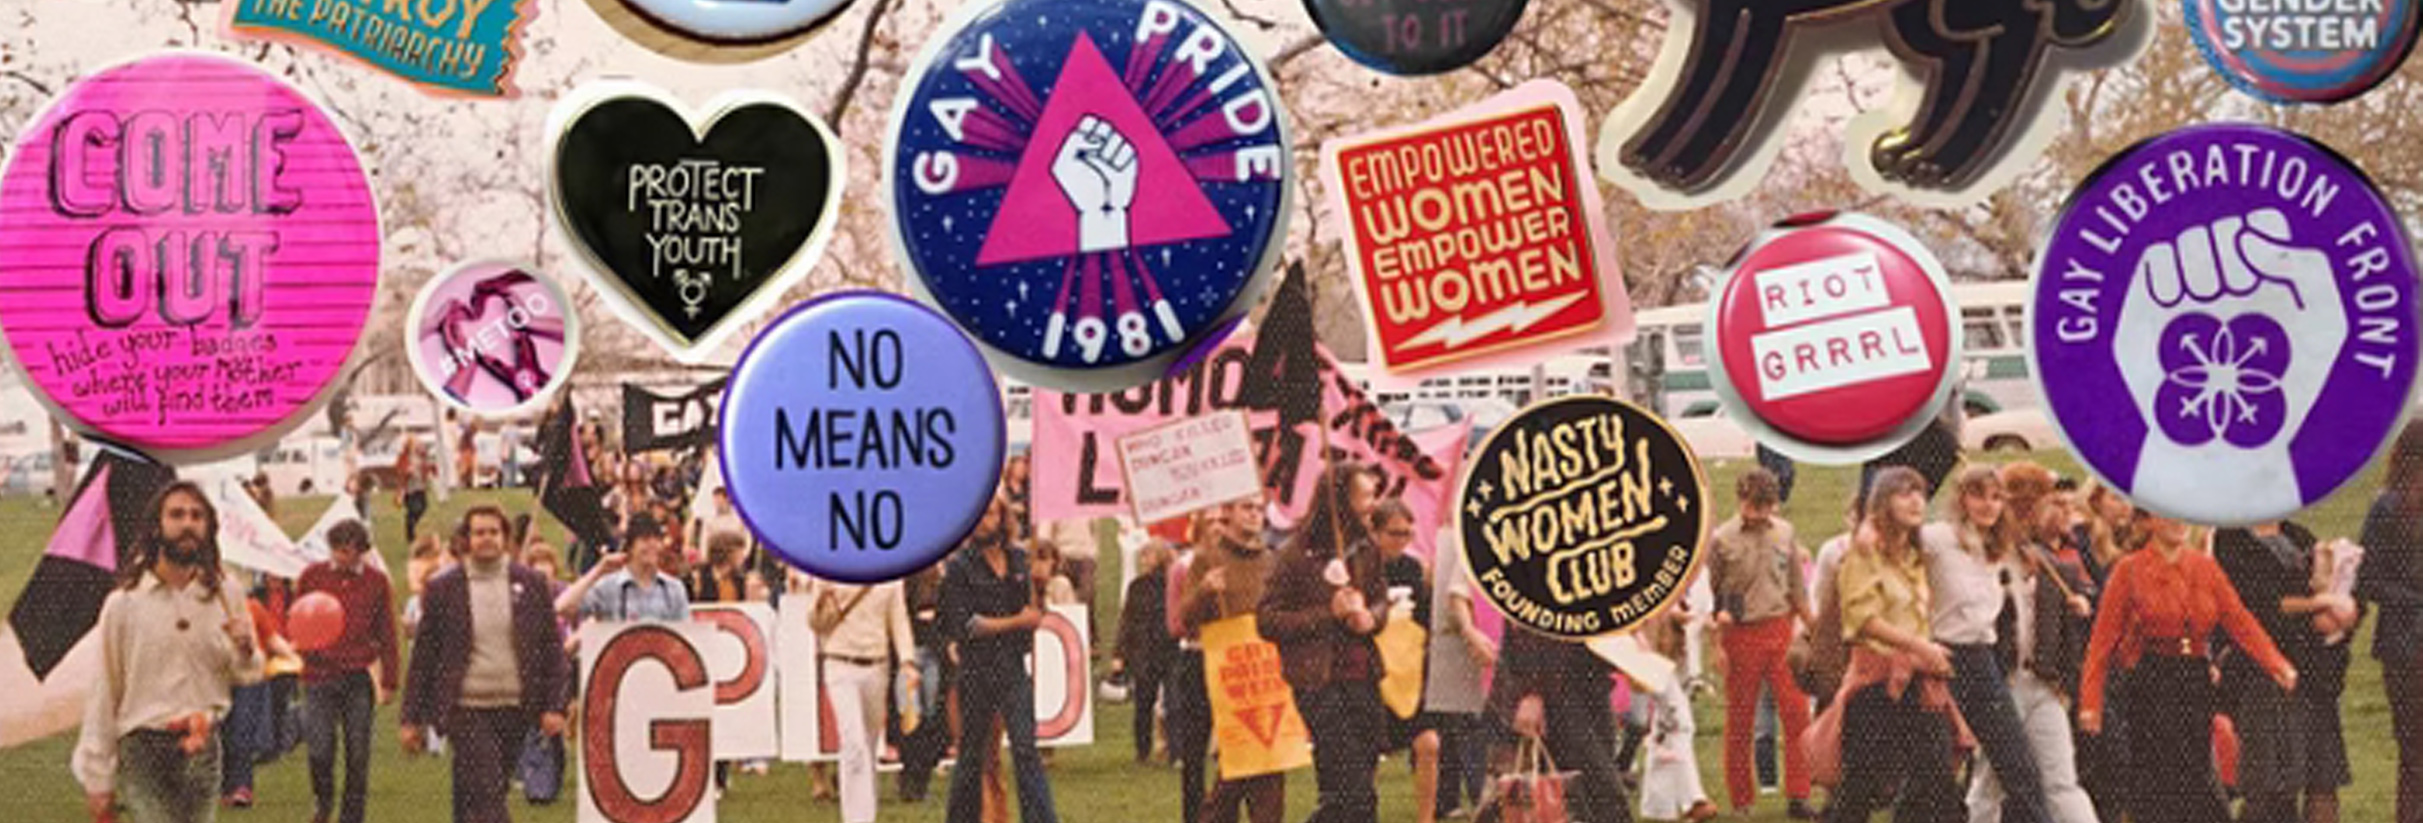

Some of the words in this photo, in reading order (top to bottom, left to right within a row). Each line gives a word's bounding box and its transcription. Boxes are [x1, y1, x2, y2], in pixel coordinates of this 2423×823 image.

[308, 0, 485, 79] PATRIARCHY
[1382, 13, 1422, 53] TO
[1440, 10, 1467, 48] IT
[2222, 15, 2378, 49] SYSTEM
[912, 33, 1001, 195] GAY
[1135, 0, 1283, 183] PRIDE
[48, 109, 305, 220] COME
[628, 158, 765, 212] PROTECT
[1350, 118, 1555, 200] EMPOWERED
[647, 199, 741, 233] TRANS
[1361, 161, 1565, 245] WOMEN
[2079, 143, 2340, 255] LIBERATION
[85, 224, 281, 331] OUT
[645, 233, 742, 280] YOUTH
[1373, 206, 1571, 280] EMPOWER
[1381, 239, 1582, 325] WOMEN
[1764, 264, 1874, 311] RIOT
[2056, 259, 2105, 343] GAY
[2335, 221, 2400, 380] FRONT
[47, 328, 112, 377] hide
[119, 330, 179, 370] your
[440, 292, 549, 376] #METOO
[829, 328, 904, 390] NO
[1041, 300, 1185, 364] 1981
[1762, 326, 1920, 382] GRRRL
[154, 363, 210, 390] your
[775, 406, 957, 471] MEANS
[1500, 414, 1626, 502] NASTY
[829, 489, 904, 551] NO
[1483, 438, 1652, 566] WOMEN
[1481, 567, 1601, 633] FOUNDING
[1610, 544, 1690, 625] MEMBER
[1547, 540, 1638, 605] CLUB
